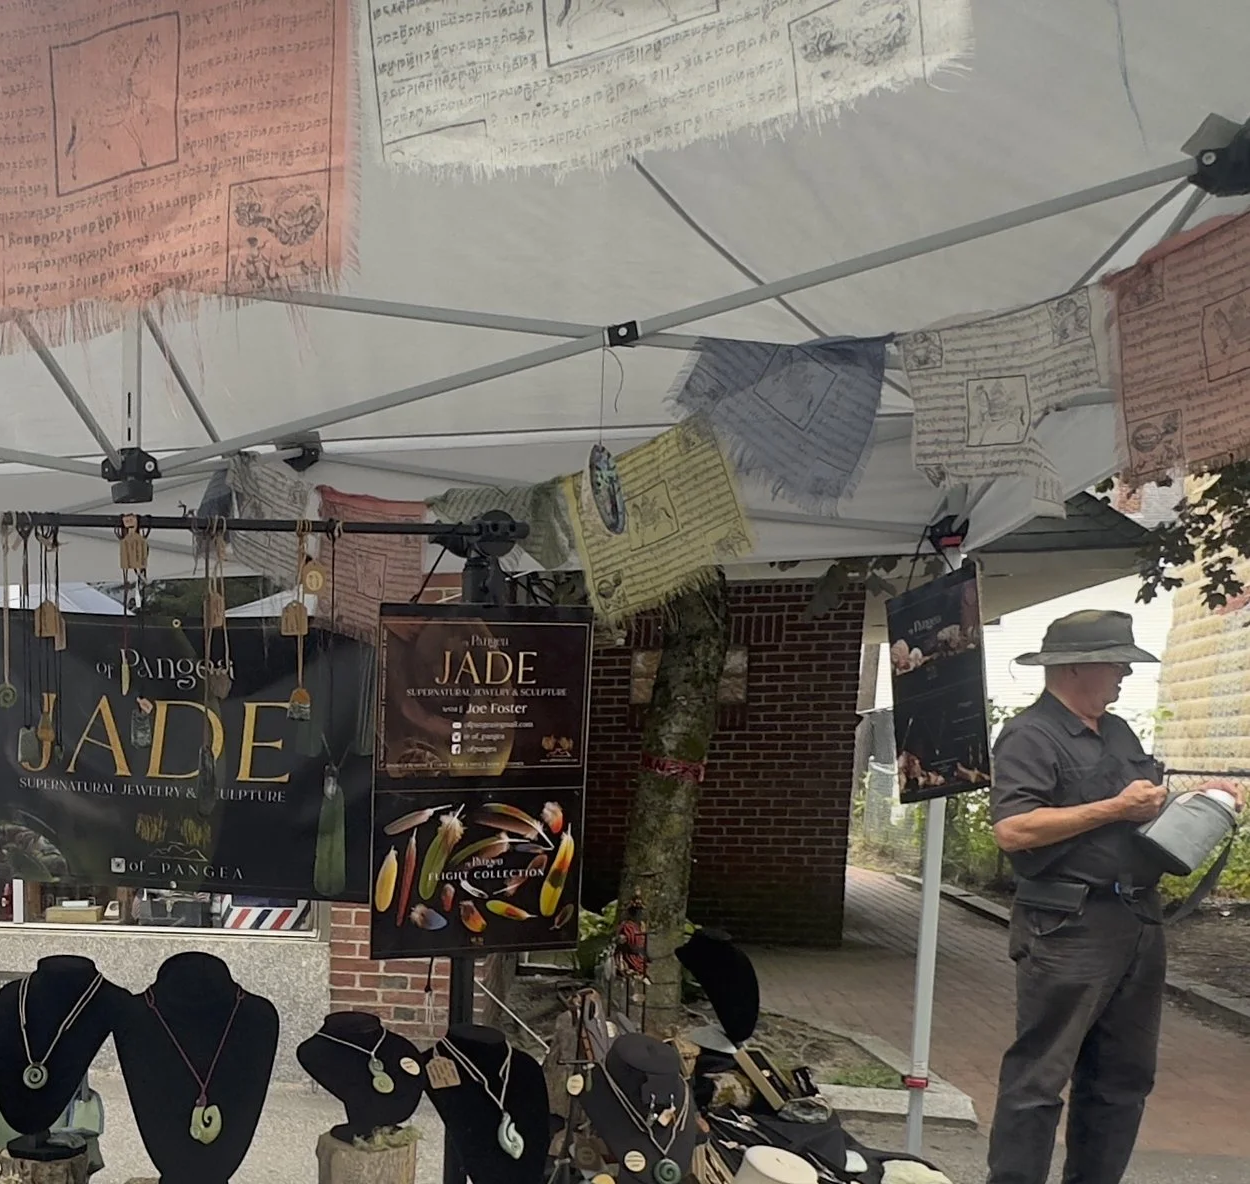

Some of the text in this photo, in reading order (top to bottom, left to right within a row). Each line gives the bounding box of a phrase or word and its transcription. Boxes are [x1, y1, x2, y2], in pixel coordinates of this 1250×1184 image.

[96, 661, 114, 680] of
[435, 651, 538, 685] JADE
[406, 688, 471, 697] SUPERNATURAL
[520, 688, 567, 697] SCULPTURE
[466, 703, 487, 714] Joe
[491, 703, 528, 714] Foster
[19, 695, 291, 783] JADE
[19, 777, 117, 795] SUPERNATURAL
[121, 784, 181, 799] JEWELRY
[186, 787, 198, 799] &
[429, 868, 545, 881] FLIGHT COLLECTION
